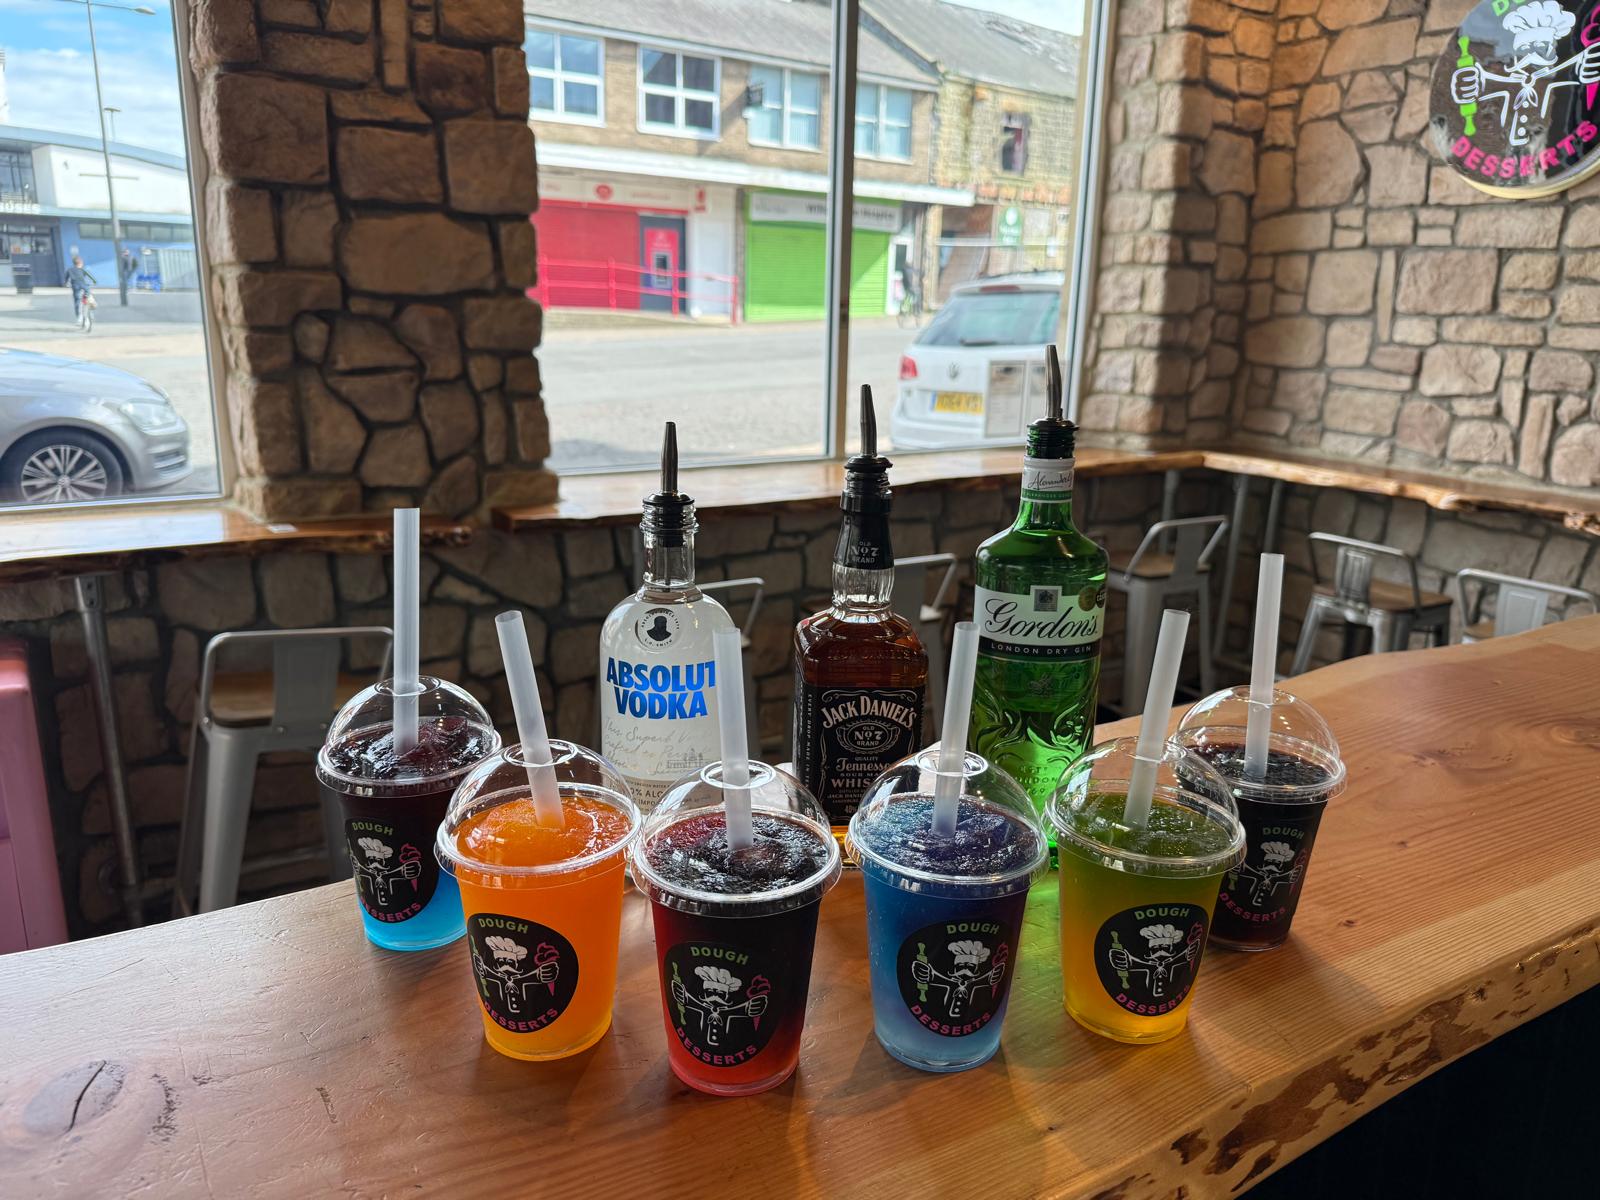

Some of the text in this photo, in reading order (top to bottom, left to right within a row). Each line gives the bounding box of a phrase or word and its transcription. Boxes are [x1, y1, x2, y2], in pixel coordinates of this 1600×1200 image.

[1452, 121, 1598, 179] DESSERTS
[985, 598, 1098, 639] Gordon's
[991, 642, 1040, 655] LONDON
[1074, 646, 1092, 654] GIN
[606, 656, 716, 693] ABSOLUT
[614, 686, 708, 720] VODKA
[821, 701, 859, 729] JACK
[860, 695, 917, 730] DANIEL'S
[835, 757, 890, 772] Tennesse
[352, 821, 394, 836] DOUGH
[1262, 827, 1304, 840] DOUGH
[360, 898, 421, 923] DESSERTS
[1134, 907, 1190, 921] DOUGH
[1219, 892, 1287, 922] DESSERTS
[478, 917, 529, 934] DOUGH
[946, 922, 1000, 935] DOUGH
[690, 946, 749, 965] DOUGH
[1116, 984, 1190, 1014] DESSERTS
[484, 1001, 558, 1031] DESSERTS
[911, 1004, 991, 1035] DESSERTS
[676, 1026, 757, 1065] DESSERTS
